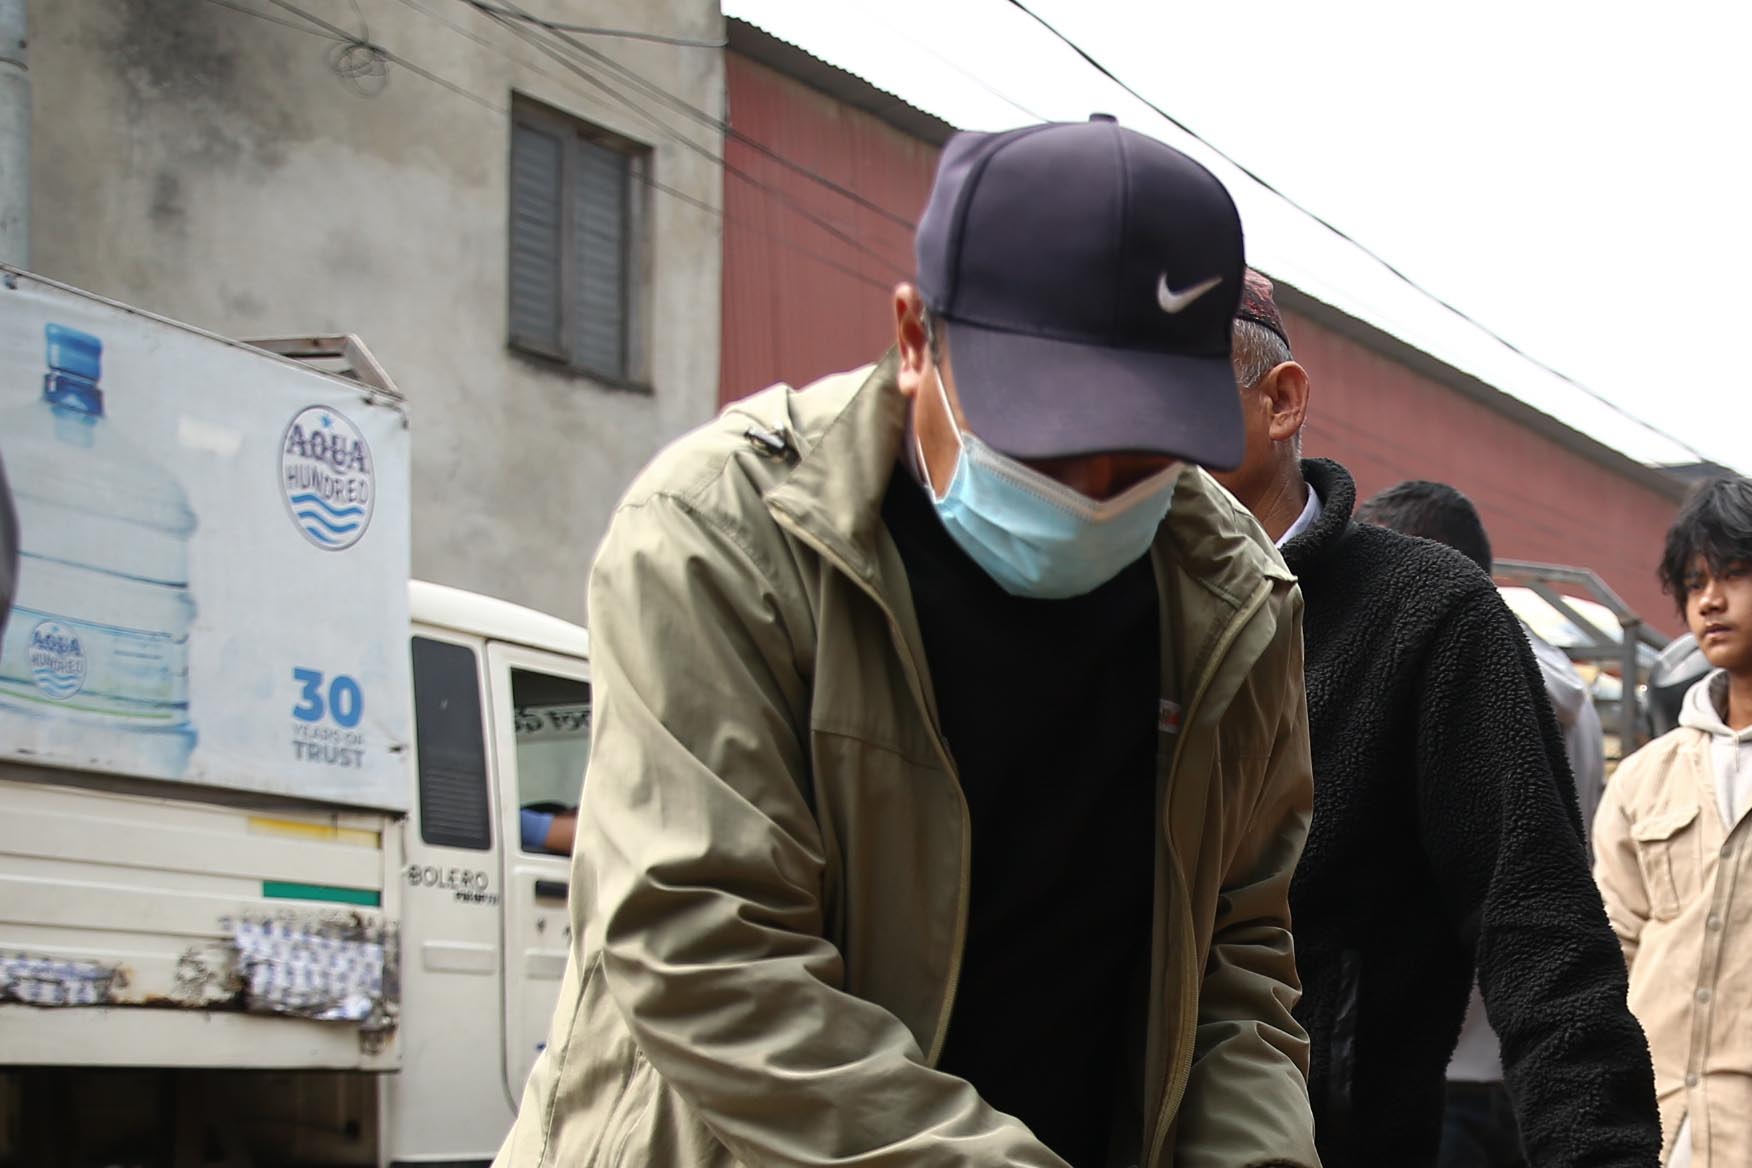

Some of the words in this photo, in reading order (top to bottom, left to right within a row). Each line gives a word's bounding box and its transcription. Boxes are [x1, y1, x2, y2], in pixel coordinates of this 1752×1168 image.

[286, 424, 368, 474] AQUA
[287, 464, 369, 504] HUNDRED
[293, 667, 364, 727] 30
[293, 740, 365, 769] TRUST
[408, 864, 489, 891] BOLERO
